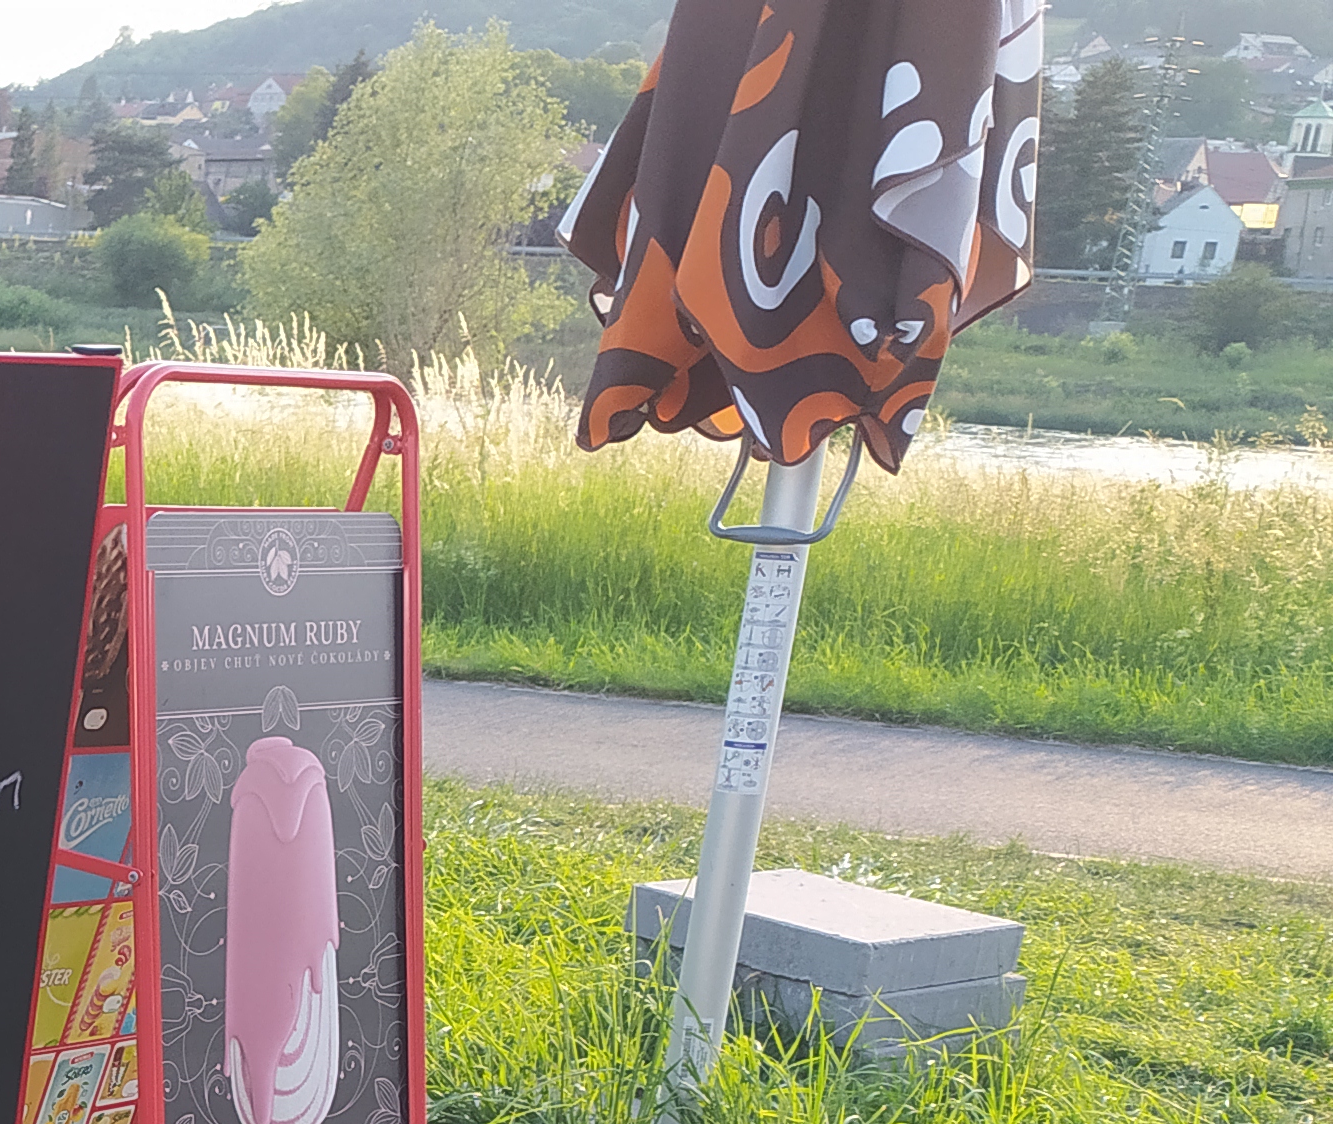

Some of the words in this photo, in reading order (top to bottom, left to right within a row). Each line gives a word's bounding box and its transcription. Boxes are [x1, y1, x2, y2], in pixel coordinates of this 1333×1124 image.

[191, 622, 297, 651] MAGNUM
[305, 620, 362, 645] RUBY
[173, 657, 217, 673] OBJEV
[268, 651, 305, 667] NOVÉ
[310, 648, 380, 665] ČOKOLÁDY
[58, 794, 131, 850] Cornetto
